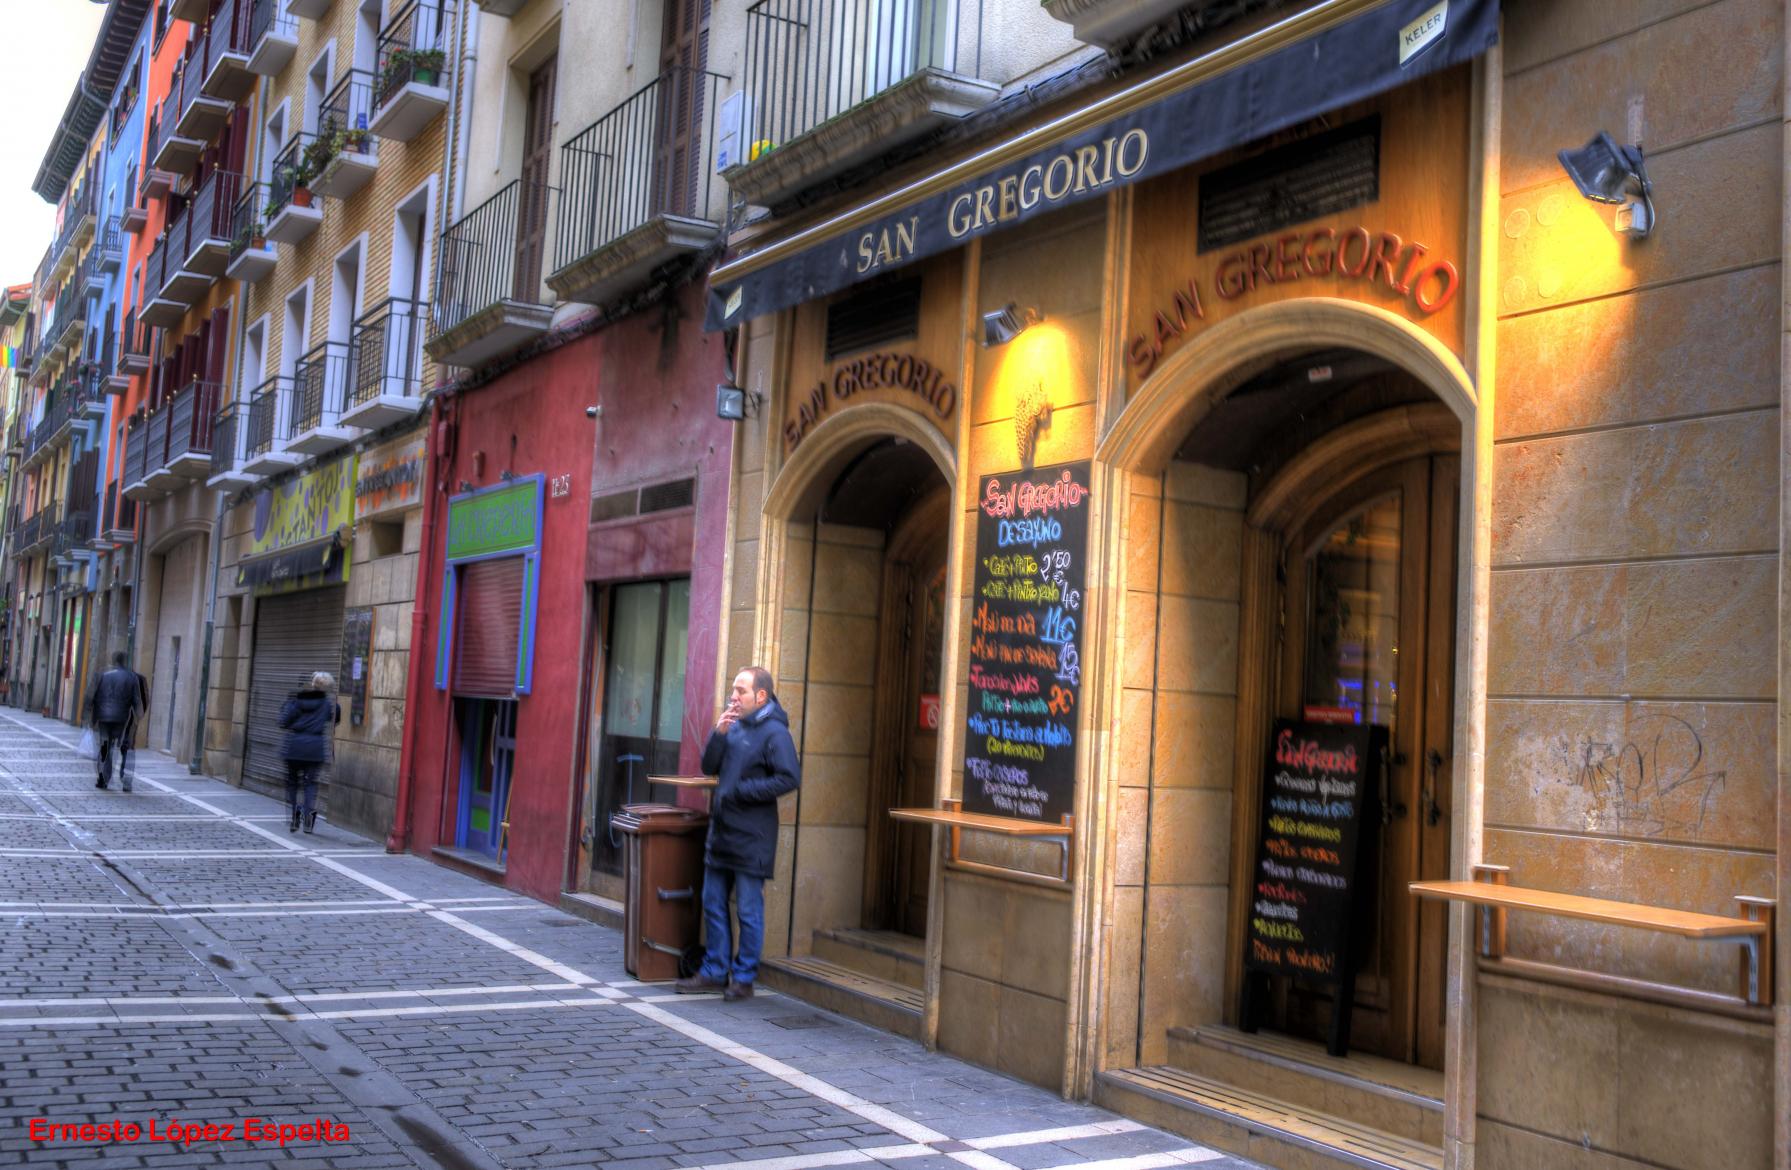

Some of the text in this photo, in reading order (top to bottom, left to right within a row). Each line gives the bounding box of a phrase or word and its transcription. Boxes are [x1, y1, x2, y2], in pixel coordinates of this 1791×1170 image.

[1404, 13, 1442, 46] KELER
[856, 216, 920, 274] SAN
[947, 128, 1149, 238] GREGORIO
[1127, 226, 1460, 381] SAN GREGORIO
[784, 352, 957, 454] SAN GREGORIO
